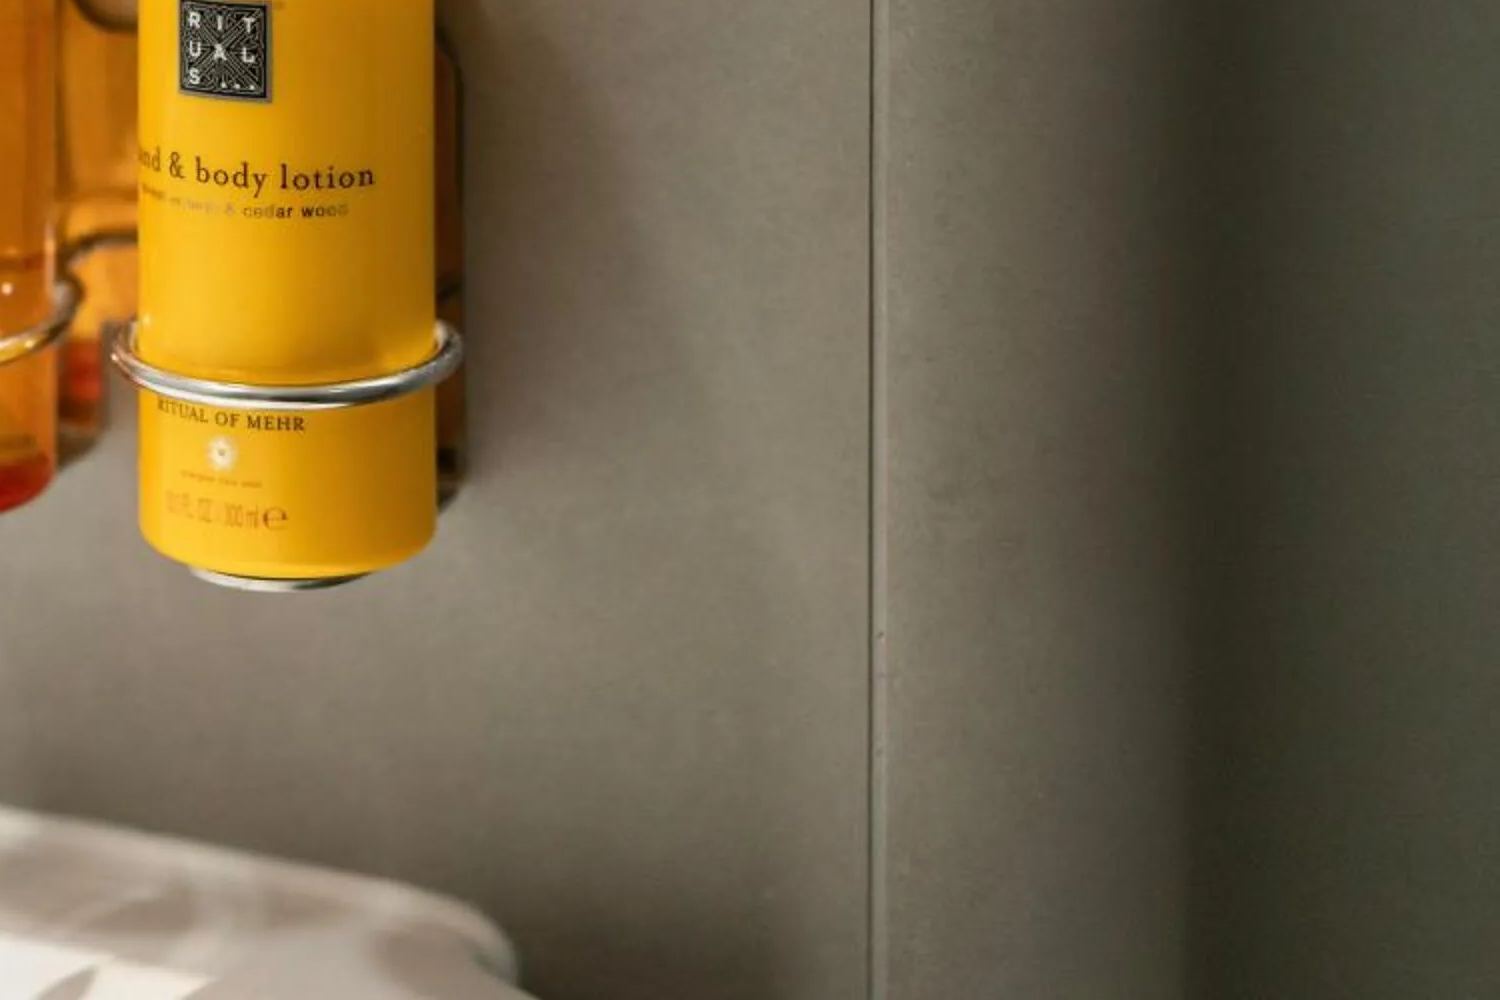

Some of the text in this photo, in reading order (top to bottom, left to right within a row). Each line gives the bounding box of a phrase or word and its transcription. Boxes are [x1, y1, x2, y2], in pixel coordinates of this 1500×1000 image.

[169, 151, 186, 179] &
[195, 155, 268, 198] body
[280, 163, 376, 191] lotion
[243, 205, 293, 219] cedar
[157, 394, 305, 432] RITUAL OF MEHR
